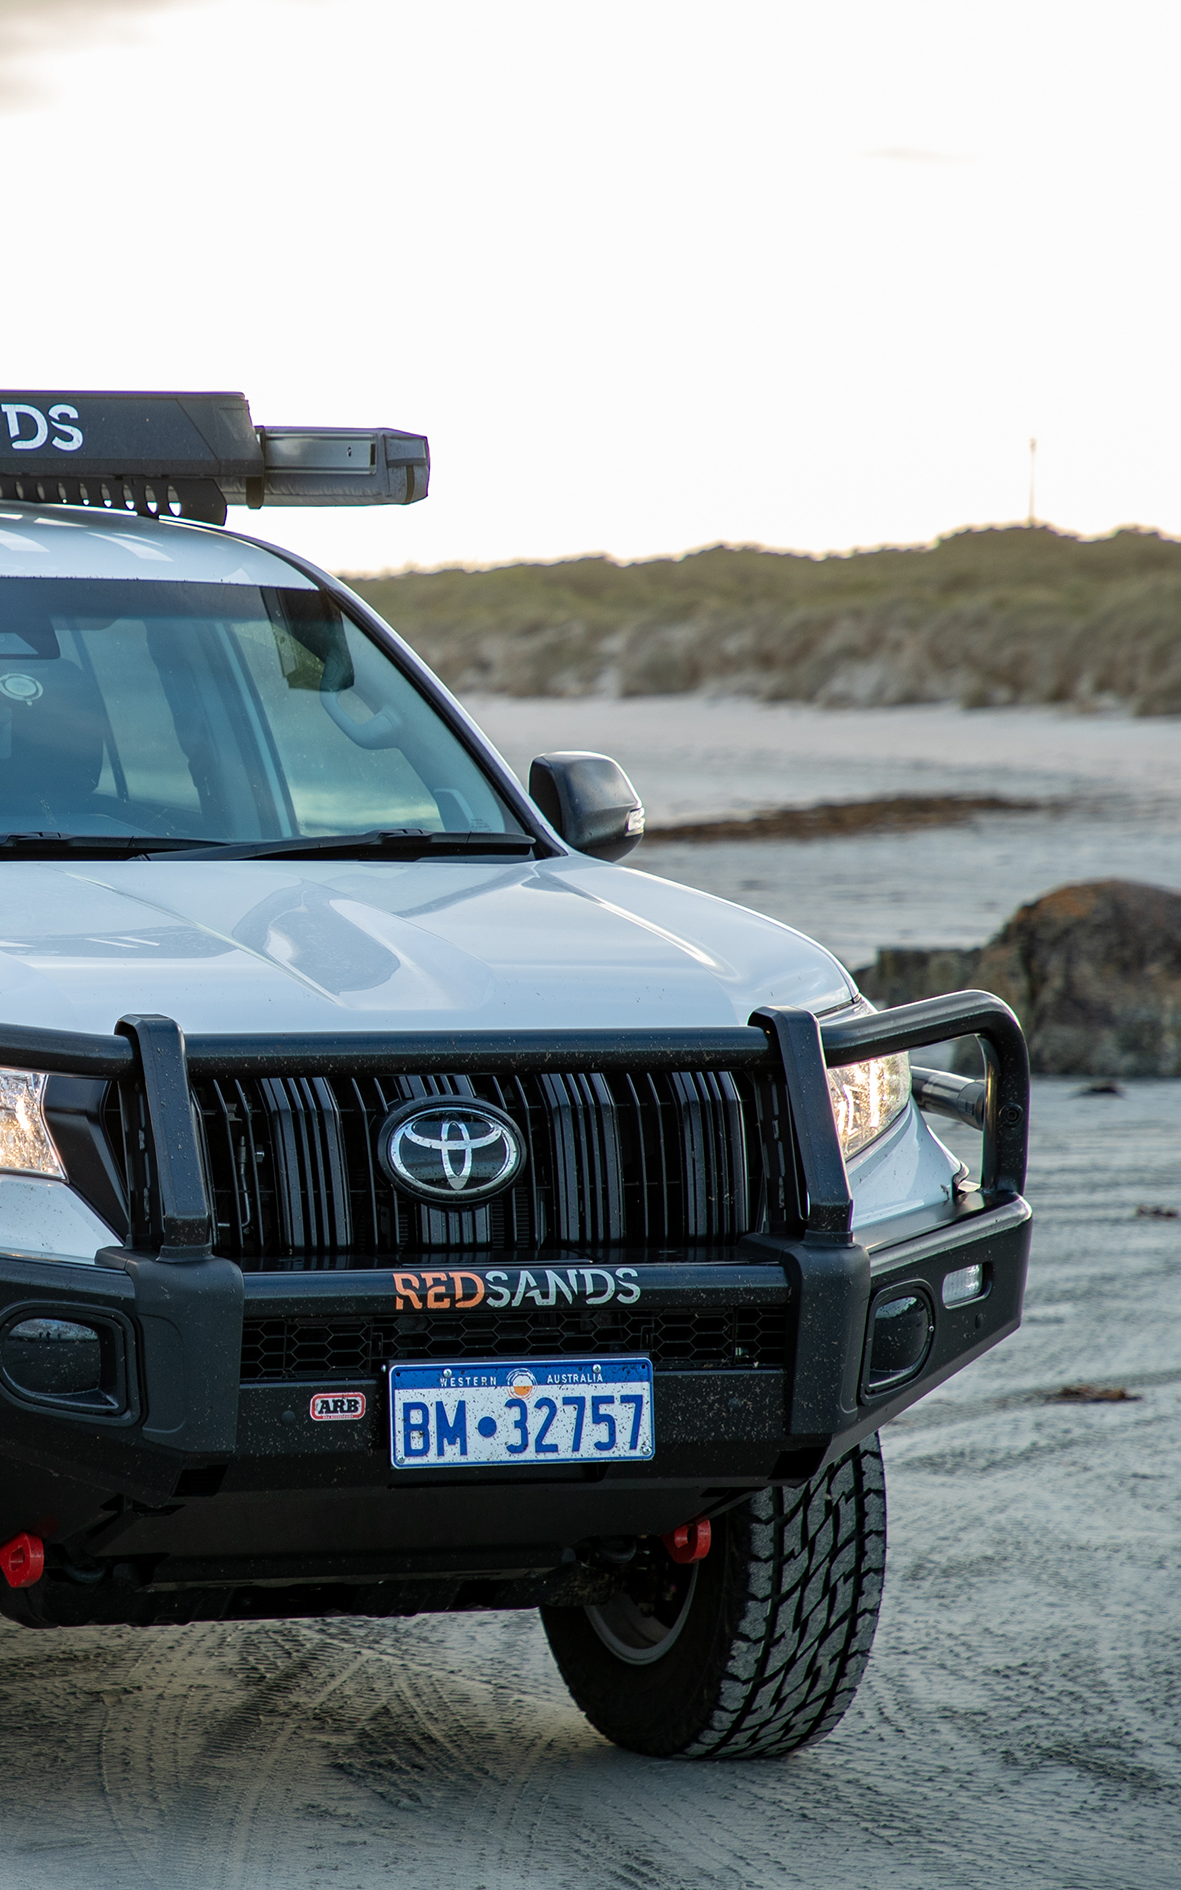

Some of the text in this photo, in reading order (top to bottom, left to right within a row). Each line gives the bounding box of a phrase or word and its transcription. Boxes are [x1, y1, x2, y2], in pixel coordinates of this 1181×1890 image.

[392, 1267, 641, 1310] REDSANDS
[439, 1373, 604, 1387] WESTERN AUSTRALIA
[317, 1398, 360, 1414] ARB
